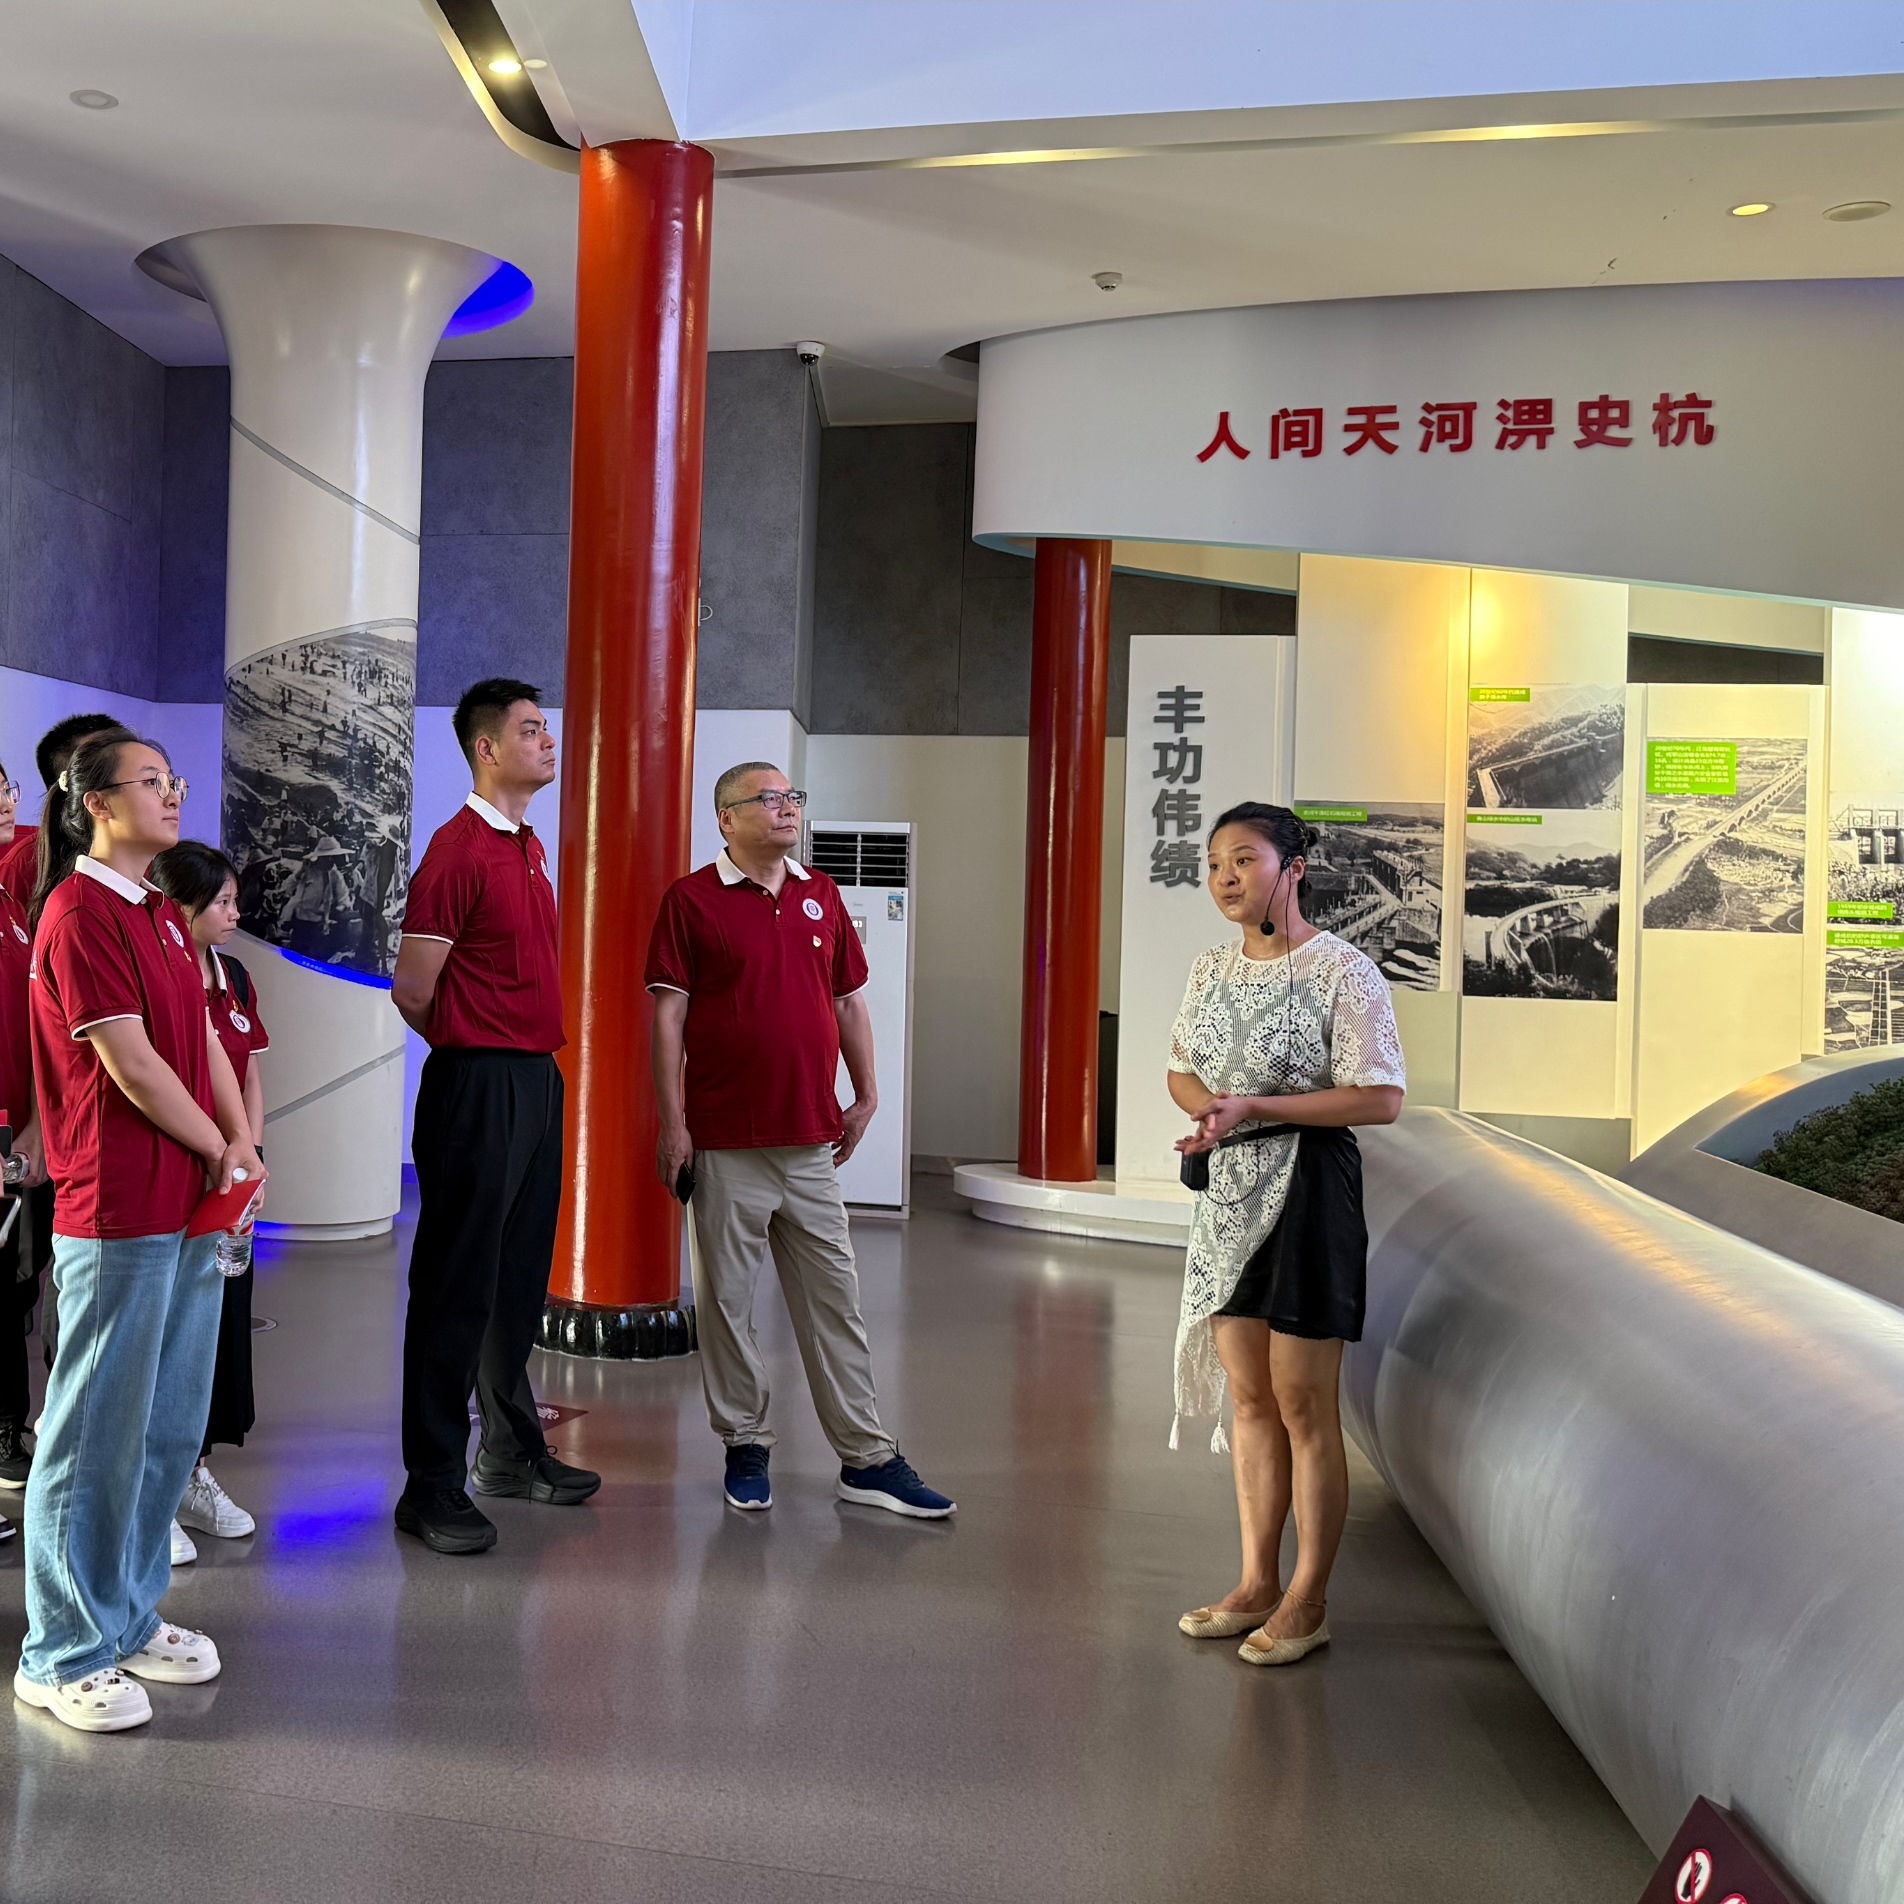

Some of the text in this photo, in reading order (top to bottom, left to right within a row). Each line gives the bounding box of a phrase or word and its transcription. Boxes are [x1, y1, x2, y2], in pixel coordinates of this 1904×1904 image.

[1197, 392, 1715, 462] 人间天河淠史杭
[1150, 685, 1205, 889] 丰功伟绩
